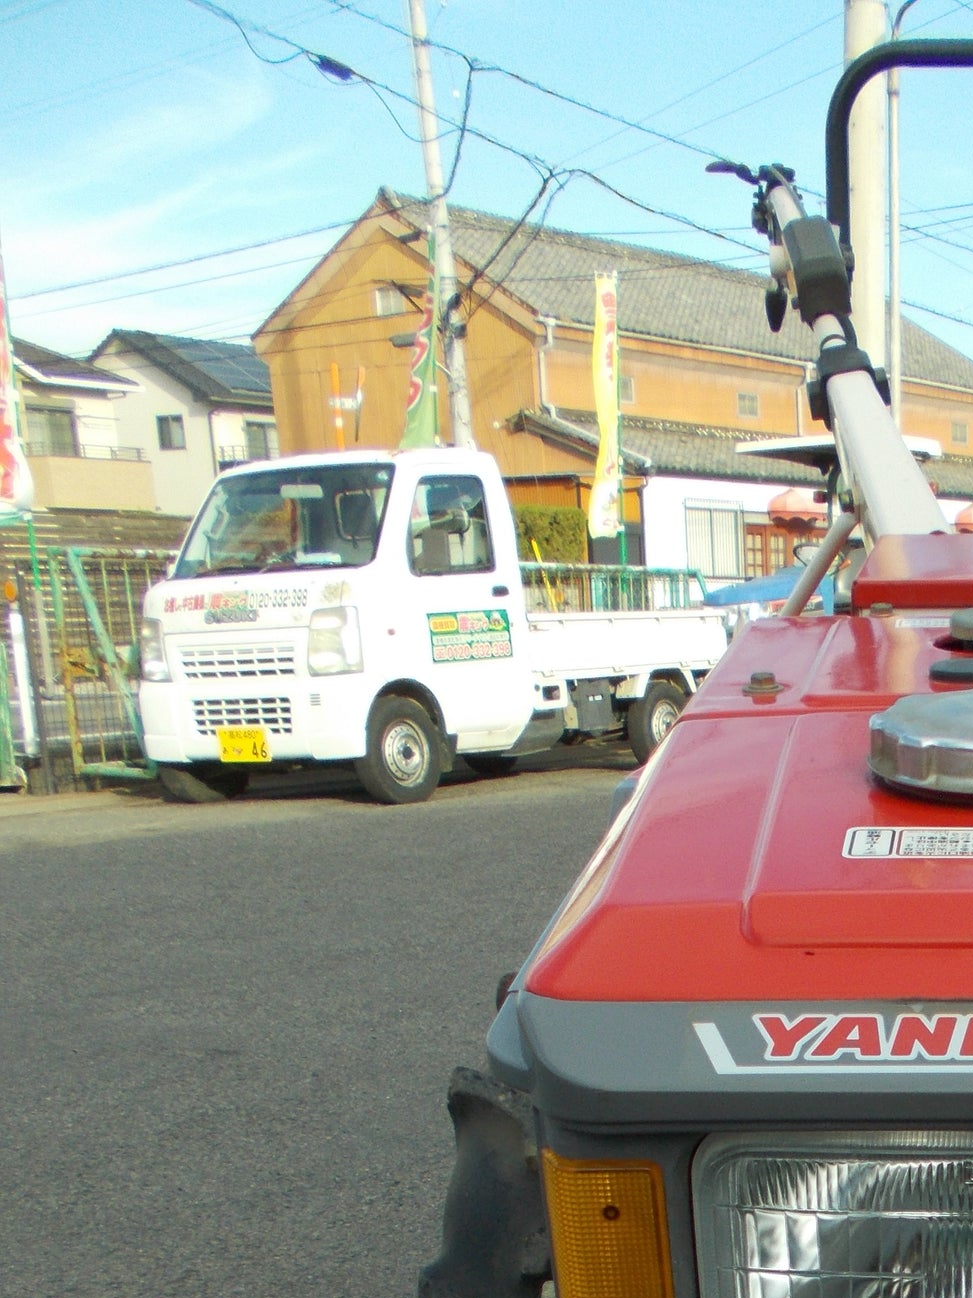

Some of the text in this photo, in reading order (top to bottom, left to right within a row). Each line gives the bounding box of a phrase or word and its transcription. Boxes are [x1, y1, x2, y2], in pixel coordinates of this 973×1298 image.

[249, 589, 308, 608] 0120-332-398
[204, 609, 260, 624] SUZUKI
[447, 642, 509, 658] 0120-332-398
